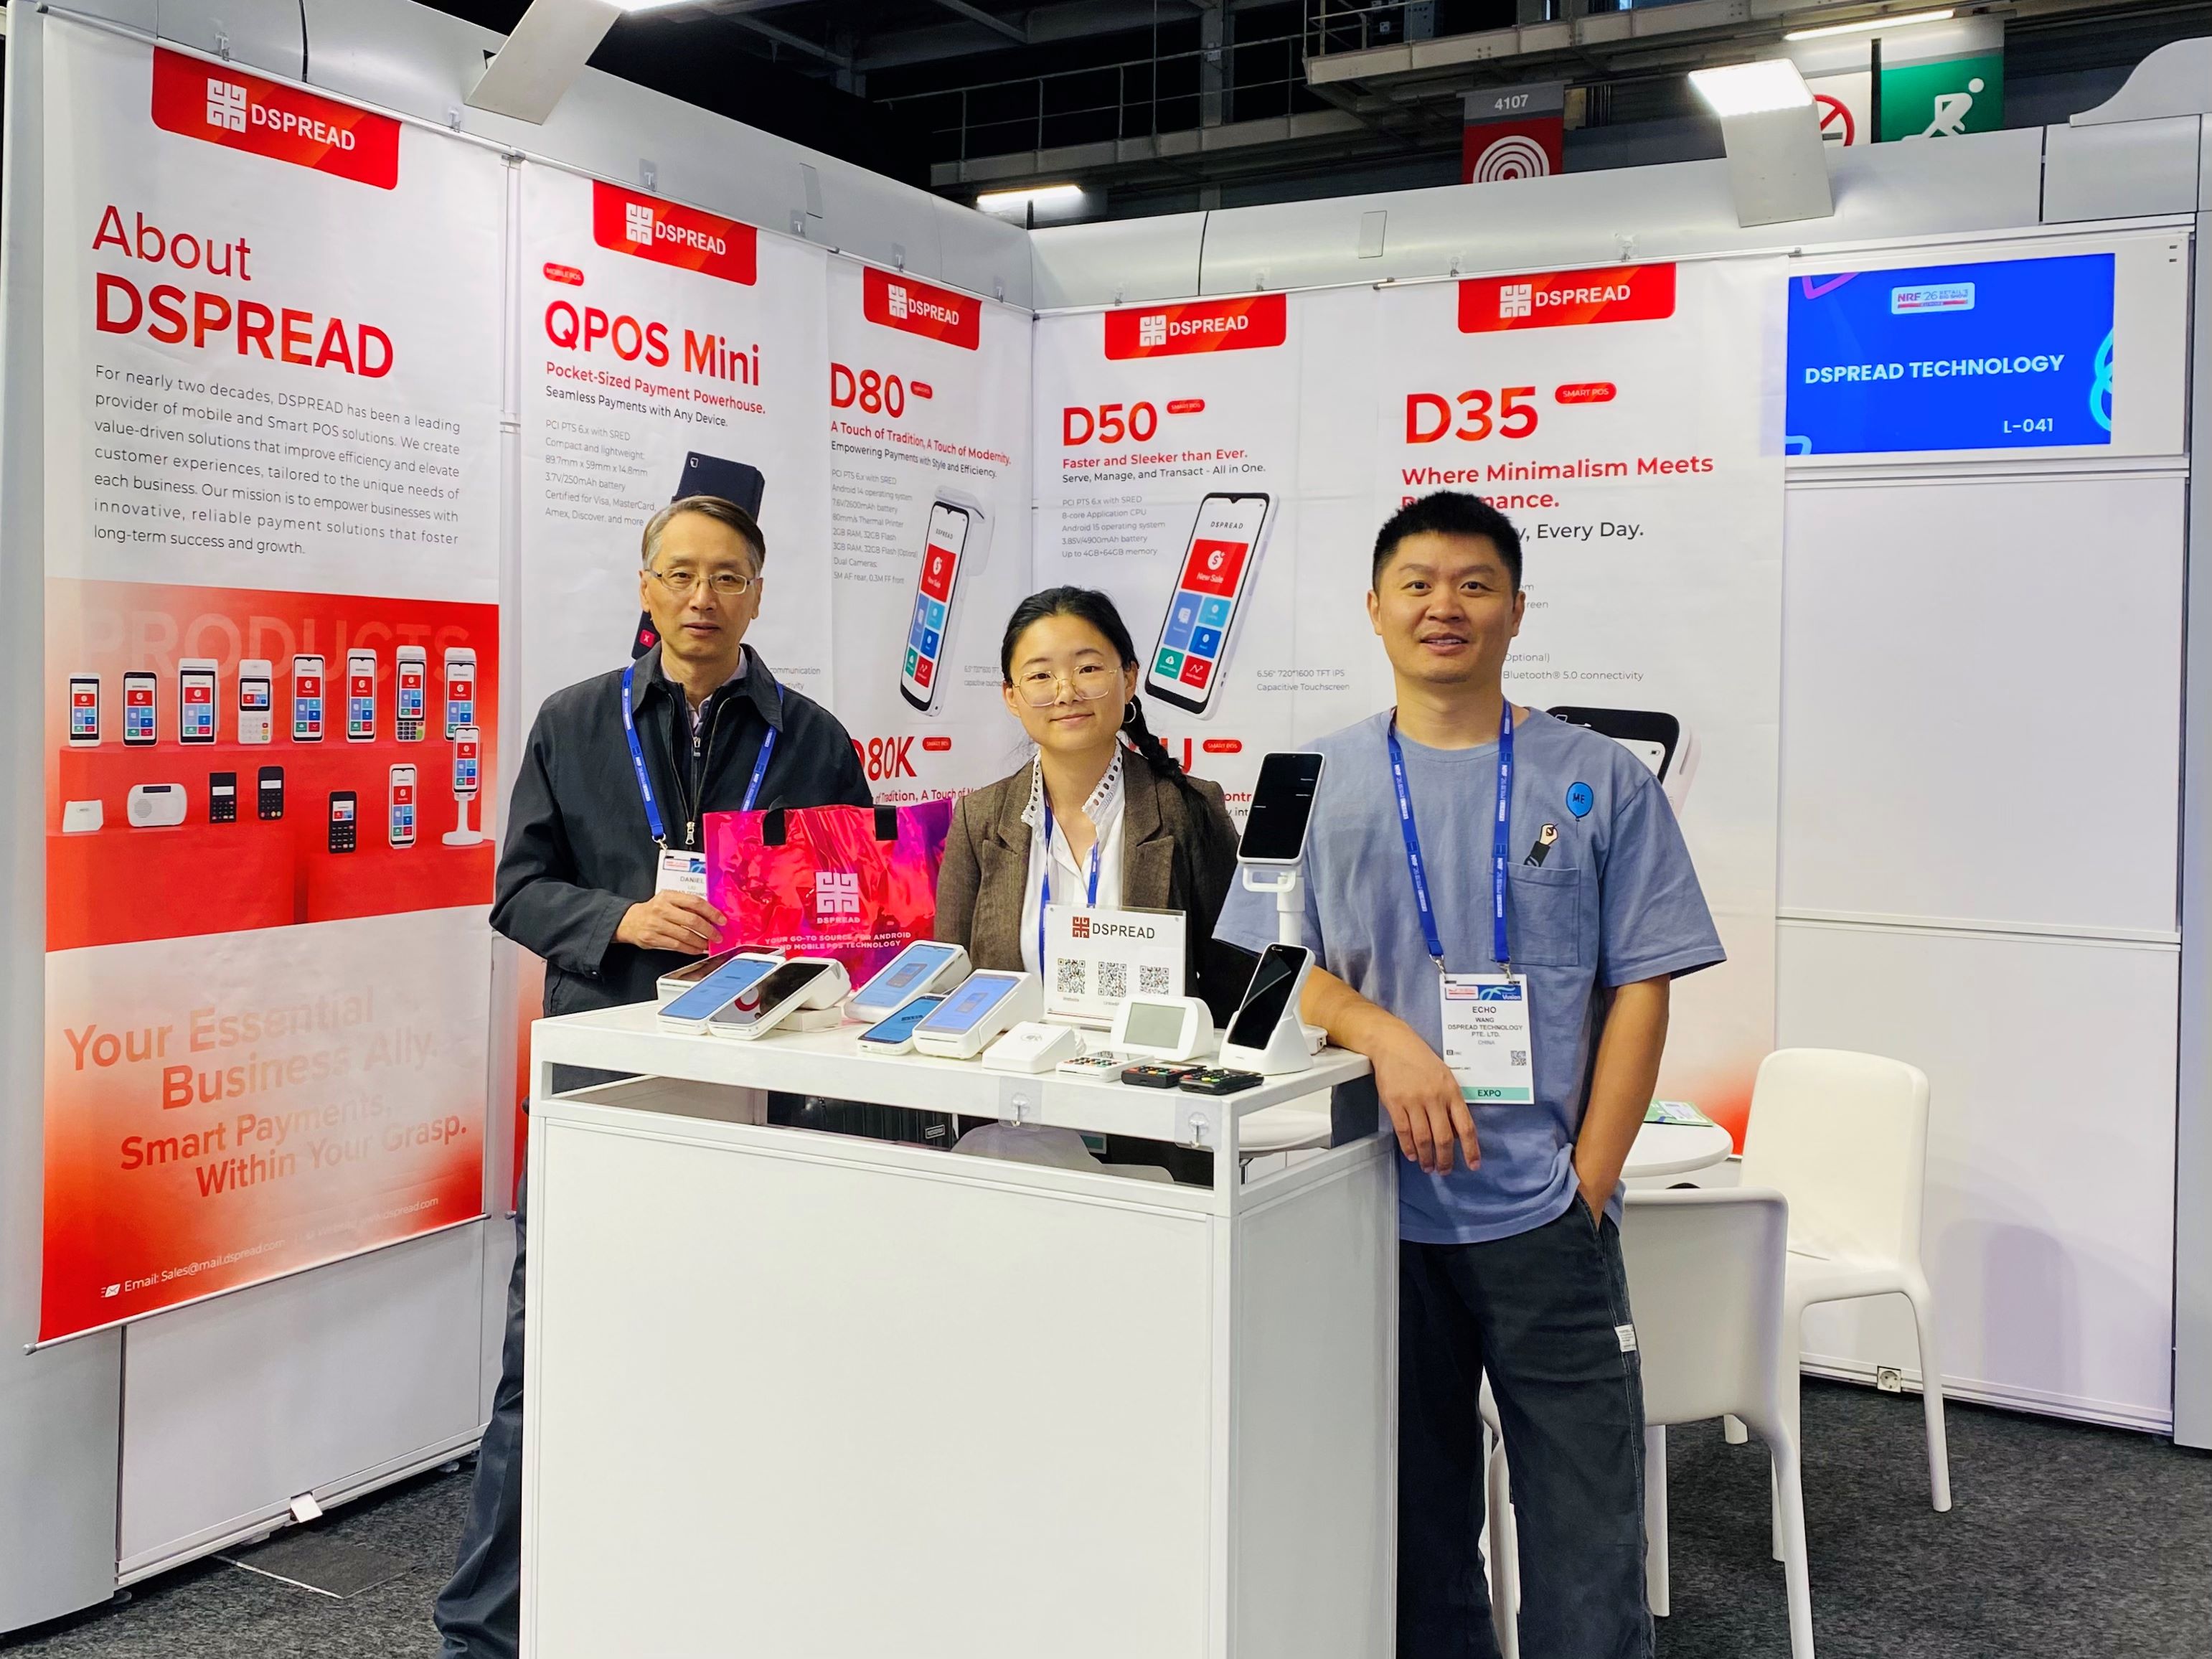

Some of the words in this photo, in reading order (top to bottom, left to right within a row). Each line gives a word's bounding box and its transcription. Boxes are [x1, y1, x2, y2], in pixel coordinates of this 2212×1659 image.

[1495, 94, 1529, 111] 4107
[251, 103, 356, 151] DSPREAD
[92, 204, 252, 281] About
[655, 221, 726, 255] DSPREAD
[908, 298, 959, 326] DSPREAD
[1535, 284, 1631, 308] DSPREAD
[1898, 293, 1921, 301] NRF
[95, 272, 394, 379] DSPREAD
[545, 300, 669, 367] QPOS
[684, 329, 759, 386] Mini
[1169, 314, 1249, 336] DSPREAD
[1805, 362, 1904, 384] DSPREAD
[1909, 354, 2065, 380] TECHNOLOGY
[95, 364, 121, 381] For
[126, 372, 174, 392] nearly
[177, 378, 205, 394] two
[210, 382, 273, 405] decades,
[278, 393, 344, 414] DSPREAD
[347, 403, 367, 418] has
[370, 407, 400, 423] been
[403, 415, 410, 426] a
[415, 414, 460, 436] leading
[547, 361, 631, 390] Pocket-Sized
[635, 378, 690, 400] Payment
[694, 389, 766, 414] Powerhouse.
[831, 362, 905, 418] D80
[1563, 389, 1590, 398] SMART
[1591, 387, 1609, 396] POS
[546, 385, 596, 405] Seamless
[598, 394, 647, 413] Payments
[649, 404, 672, 418] with
[673, 408, 694, 423] Any
[695, 411, 728, 427] Device.
[1063, 401, 1158, 446] D50
[1406, 385, 1538, 443] D35
[95, 394, 159, 413] provider
[163, 402, 178, 415] of
[182, 406, 232, 423] mobile
[237, 414, 263, 427] and
[267, 415, 309, 433] Smart
[312, 422, 339, 438] POS
[342, 428, 397, 446] solutions.
[400, 436, 420, 450] We
[423, 441, 460, 455] create
[2004, 418, 2053, 434] L-041
[94, 420, 184, 442] value-driven
[187, 431, 251, 450] solutions
[253, 438, 281, 454] that
[284, 445, 336, 461] improve
[338, 450, 392, 471] efficiency
[393, 460, 416, 472] and
[418, 461, 460, 477] elevate
[830, 420, 839, 433] A
[840, 422, 872, 438] Touch
[874, 429, 885, 440] of
[886, 430, 926, 448] Tradition,
[926, 438, 933, 450] A
[933, 440, 956, 454] Touch
[958, 446, 966, 456] of
[968, 447, 1012, 466] Modernity.
[831, 440, 883, 459] Empowering
[884, 448, 919, 464] Payments
[919, 456, 931, 466] with
[931, 458, 946, 471] Style
[947, 463, 959, 472] and
[960, 464, 997, 479] Efficiency.
[1063, 458, 1101, 469] Faster
[1103, 454, 1127, 466] and
[1131, 452, 1178, 465] Sleeker
[1182, 451, 1212, 462] than
[1216, 449, 1248, 460] Ever.
[95, 448, 169, 466] customer
[173, 457, 264, 478] experiences,
[268, 466, 319, 483] tailored
[324, 472, 336, 485] to
[339, 474, 360, 488] the
[363, 480, 405, 494] unique
[408, 485, 444, 499] needs
[447, 488, 460, 499] of
[1062, 474, 1092, 484] Serve,
[1094, 472, 1136, 482] Manage,
[1137, 469, 1157, 479] and
[1159, 467, 1204, 477] Transact
[1212, 464, 1226, 475] All
[1241, 464, 1266, 473] One.
[1402, 466, 1479, 486] Where
[1487, 458, 1628, 482] Minimalism
[1637, 456, 1713, 475] Meets
[94, 474, 129, 488] each
[133, 475, 198, 494] business.
[201, 483, 229, 497] Our
[232, 487, 281, 503] mission
[285, 494, 295, 505] is
[297, 494, 311, 507] to
[314, 497, 369, 512] empower
[371, 501, 431, 520] businesses
[433, 510, 458, 522] with
[94, 525, 166, 544] long-term
[170, 534, 225, 548] success
[227, 537, 253, 550] and
[256, 541, 305, 554] growth.
[95, 498, 185, 522] innovative,
[192, 508, 252, 525] reliable
[258, 516, 322, 532] payment
[326, 521, 385, 538] solutions
[390, 527, 417, 541] that
[421, 530, 458, 545] foster
[1537, 523, 1594, 542] Every
[1600, 522, 1644, 540] Day.
[1256, 669, 1276, 678] 6.56"
[1332, 669, 1345, 677] IPS
[1256, 683, 1299, 692] Capacitive
[1299, 682, 1350, 691] Touchscreen
[1563, 670, 1578, 680] 5.0
[1580, 672, 1644, 682] connectivity
[1573, 791, 1585, 804] ME
[846, 940, 901, 949] TECHNOLOGY
[1092, 923, 1155, 939] DSPREAD
[63, 1023, 173, 1071] Your
[189, 985, 374, 1053] Essential
[161, 1048, 351, 1110] Business
[121, 1121, 227, 1170] Smart
[196, 1149, 296, 1198] Within
[309, 1137, 375, 1169] Your
[381, 1114, 467, 1152] Grasp.
[124, 1274, 159, 1292] Email:
